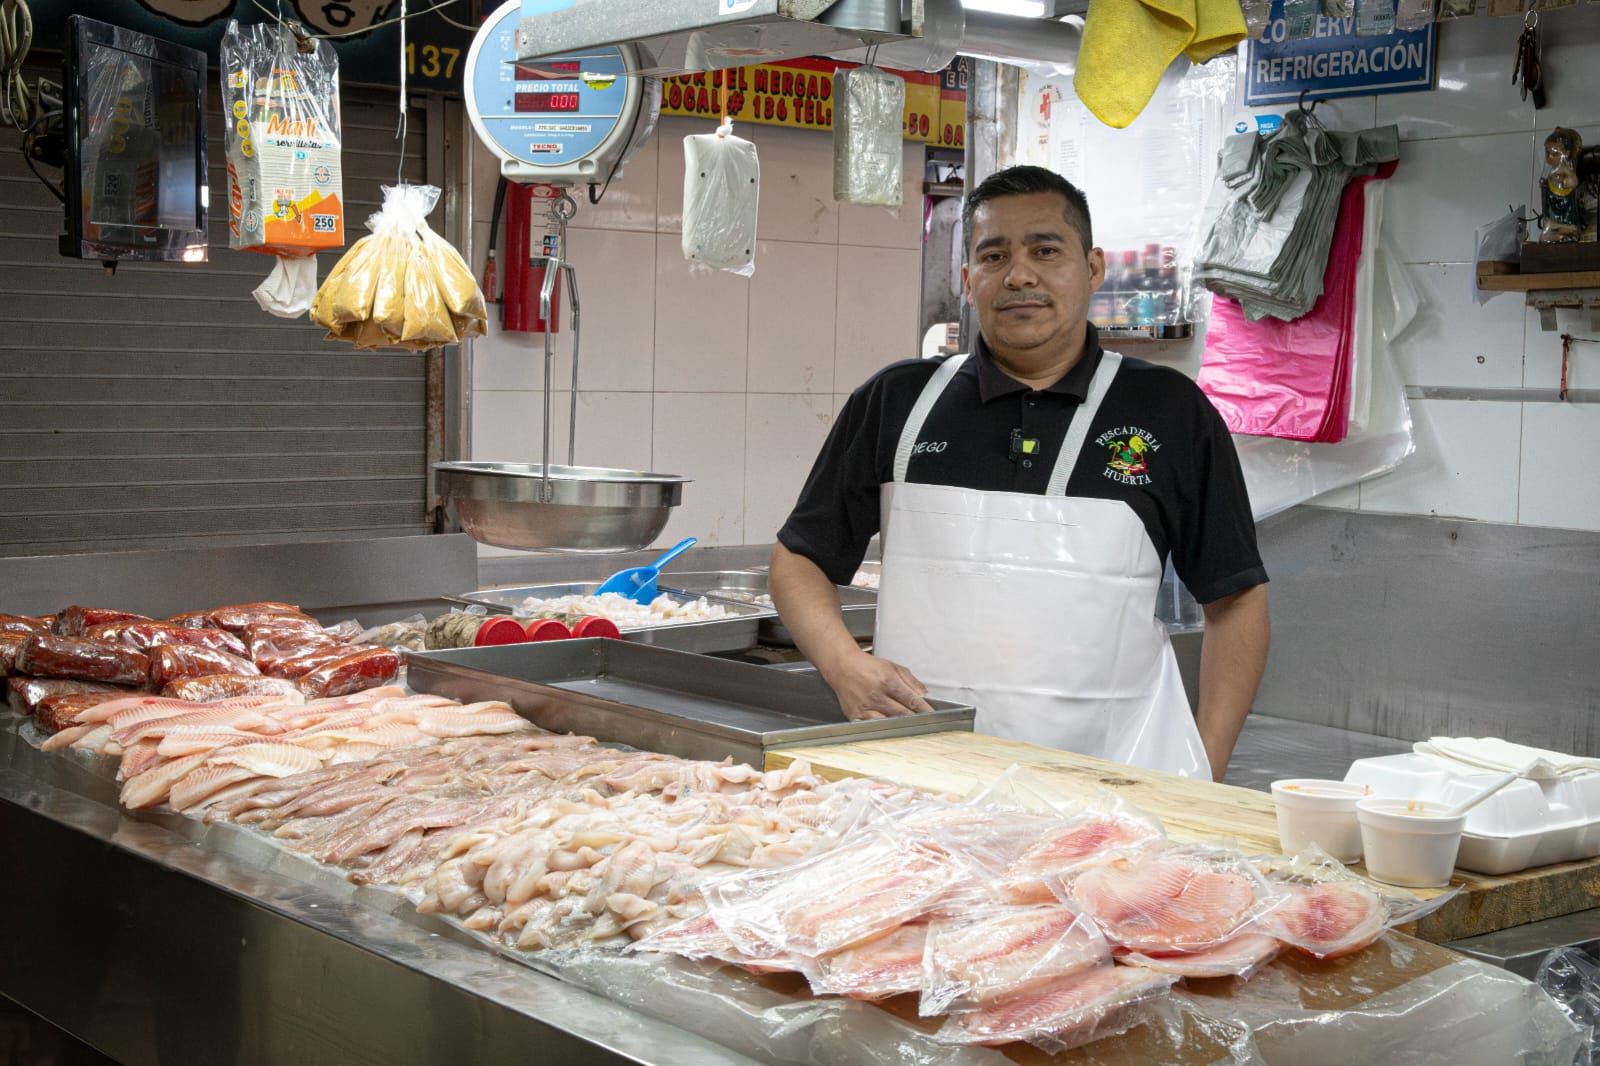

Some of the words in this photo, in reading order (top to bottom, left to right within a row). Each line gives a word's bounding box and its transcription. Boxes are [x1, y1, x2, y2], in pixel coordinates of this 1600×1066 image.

[406, 43, 460, 79] 137
[1257, 40, 1423, 84] REFRIGERACIÓN
[515, 83, 549, 93] PRECIO
[551, 83, 580, 93] TOTAL
[661, 83, 721, 114] LOCAL
[753, 95, 788, 121] 136
[793, 98, 832, 127] TEL:
[315, 217, 335, 228] 250
[1096, 425, 1162, 453] PESCADERIA
[1102, 466, 1153, 485] HUERTA
